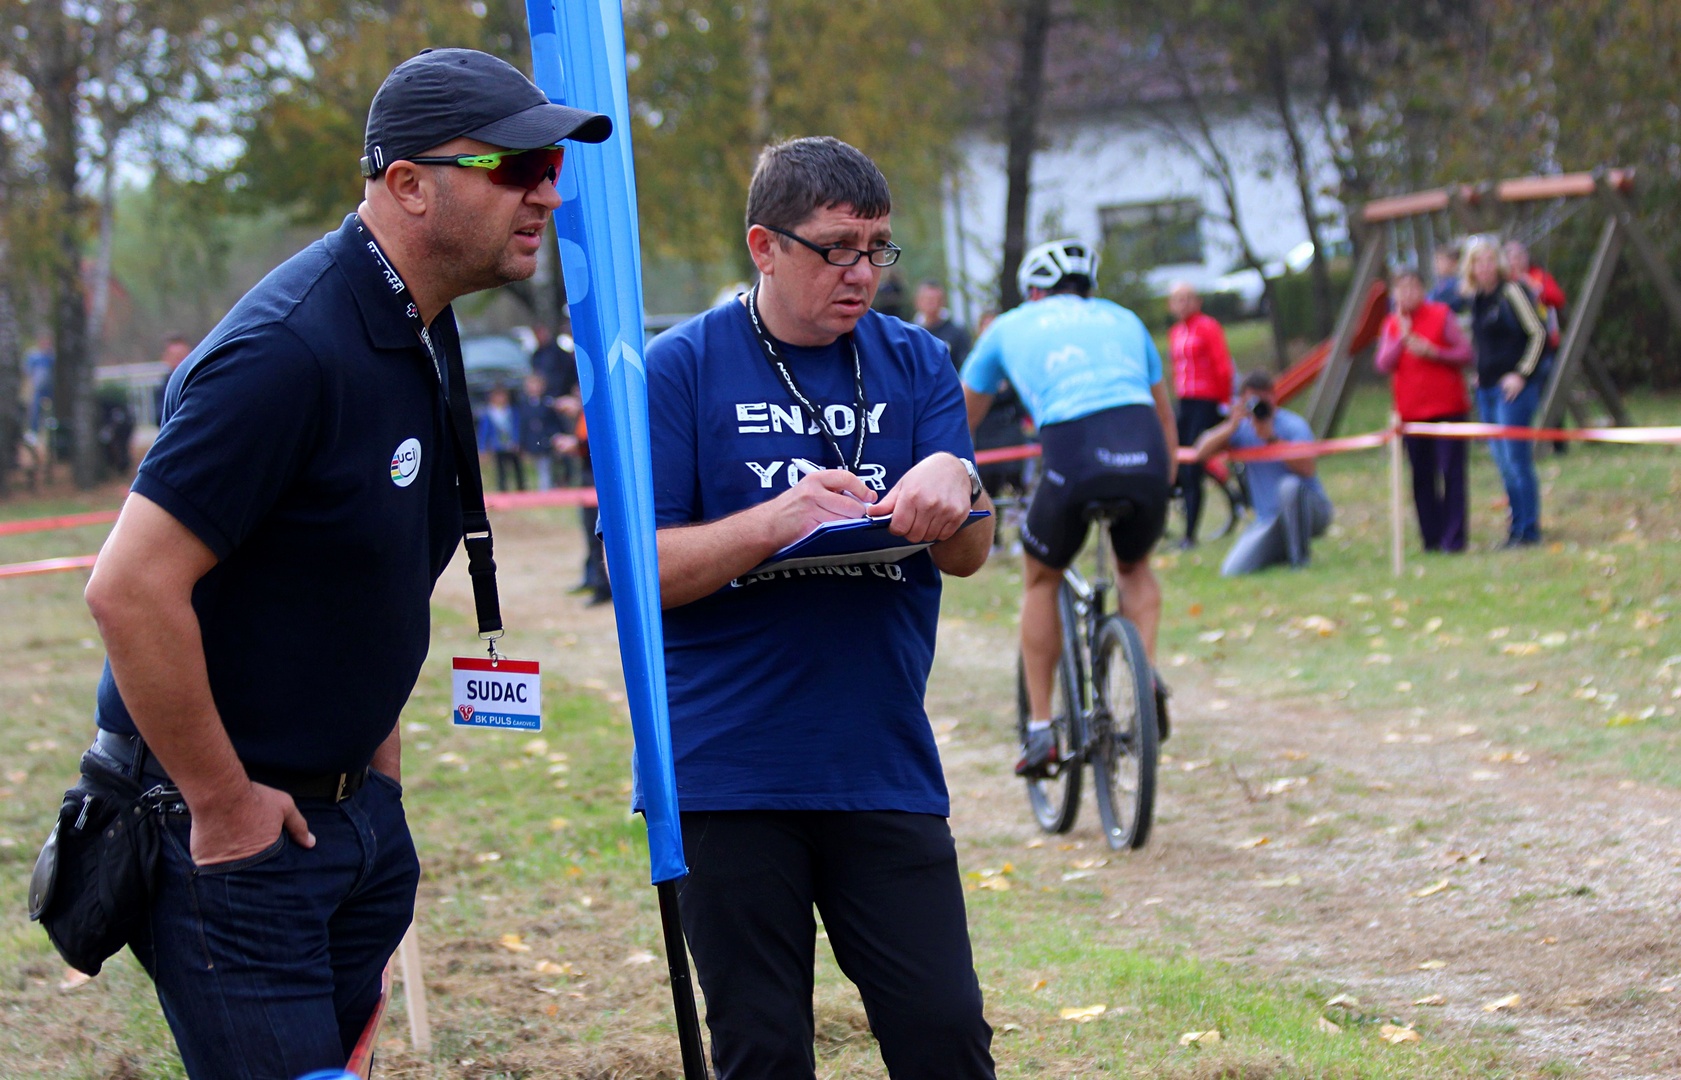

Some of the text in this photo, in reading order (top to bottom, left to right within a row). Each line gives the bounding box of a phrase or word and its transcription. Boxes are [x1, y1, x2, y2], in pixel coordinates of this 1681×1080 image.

[745, 461, 887, 491] YR
[467, 680, 527, 703] SUDAC
[475, 715, 487, 724] BK
[489, 715, 512, 726] PULS
